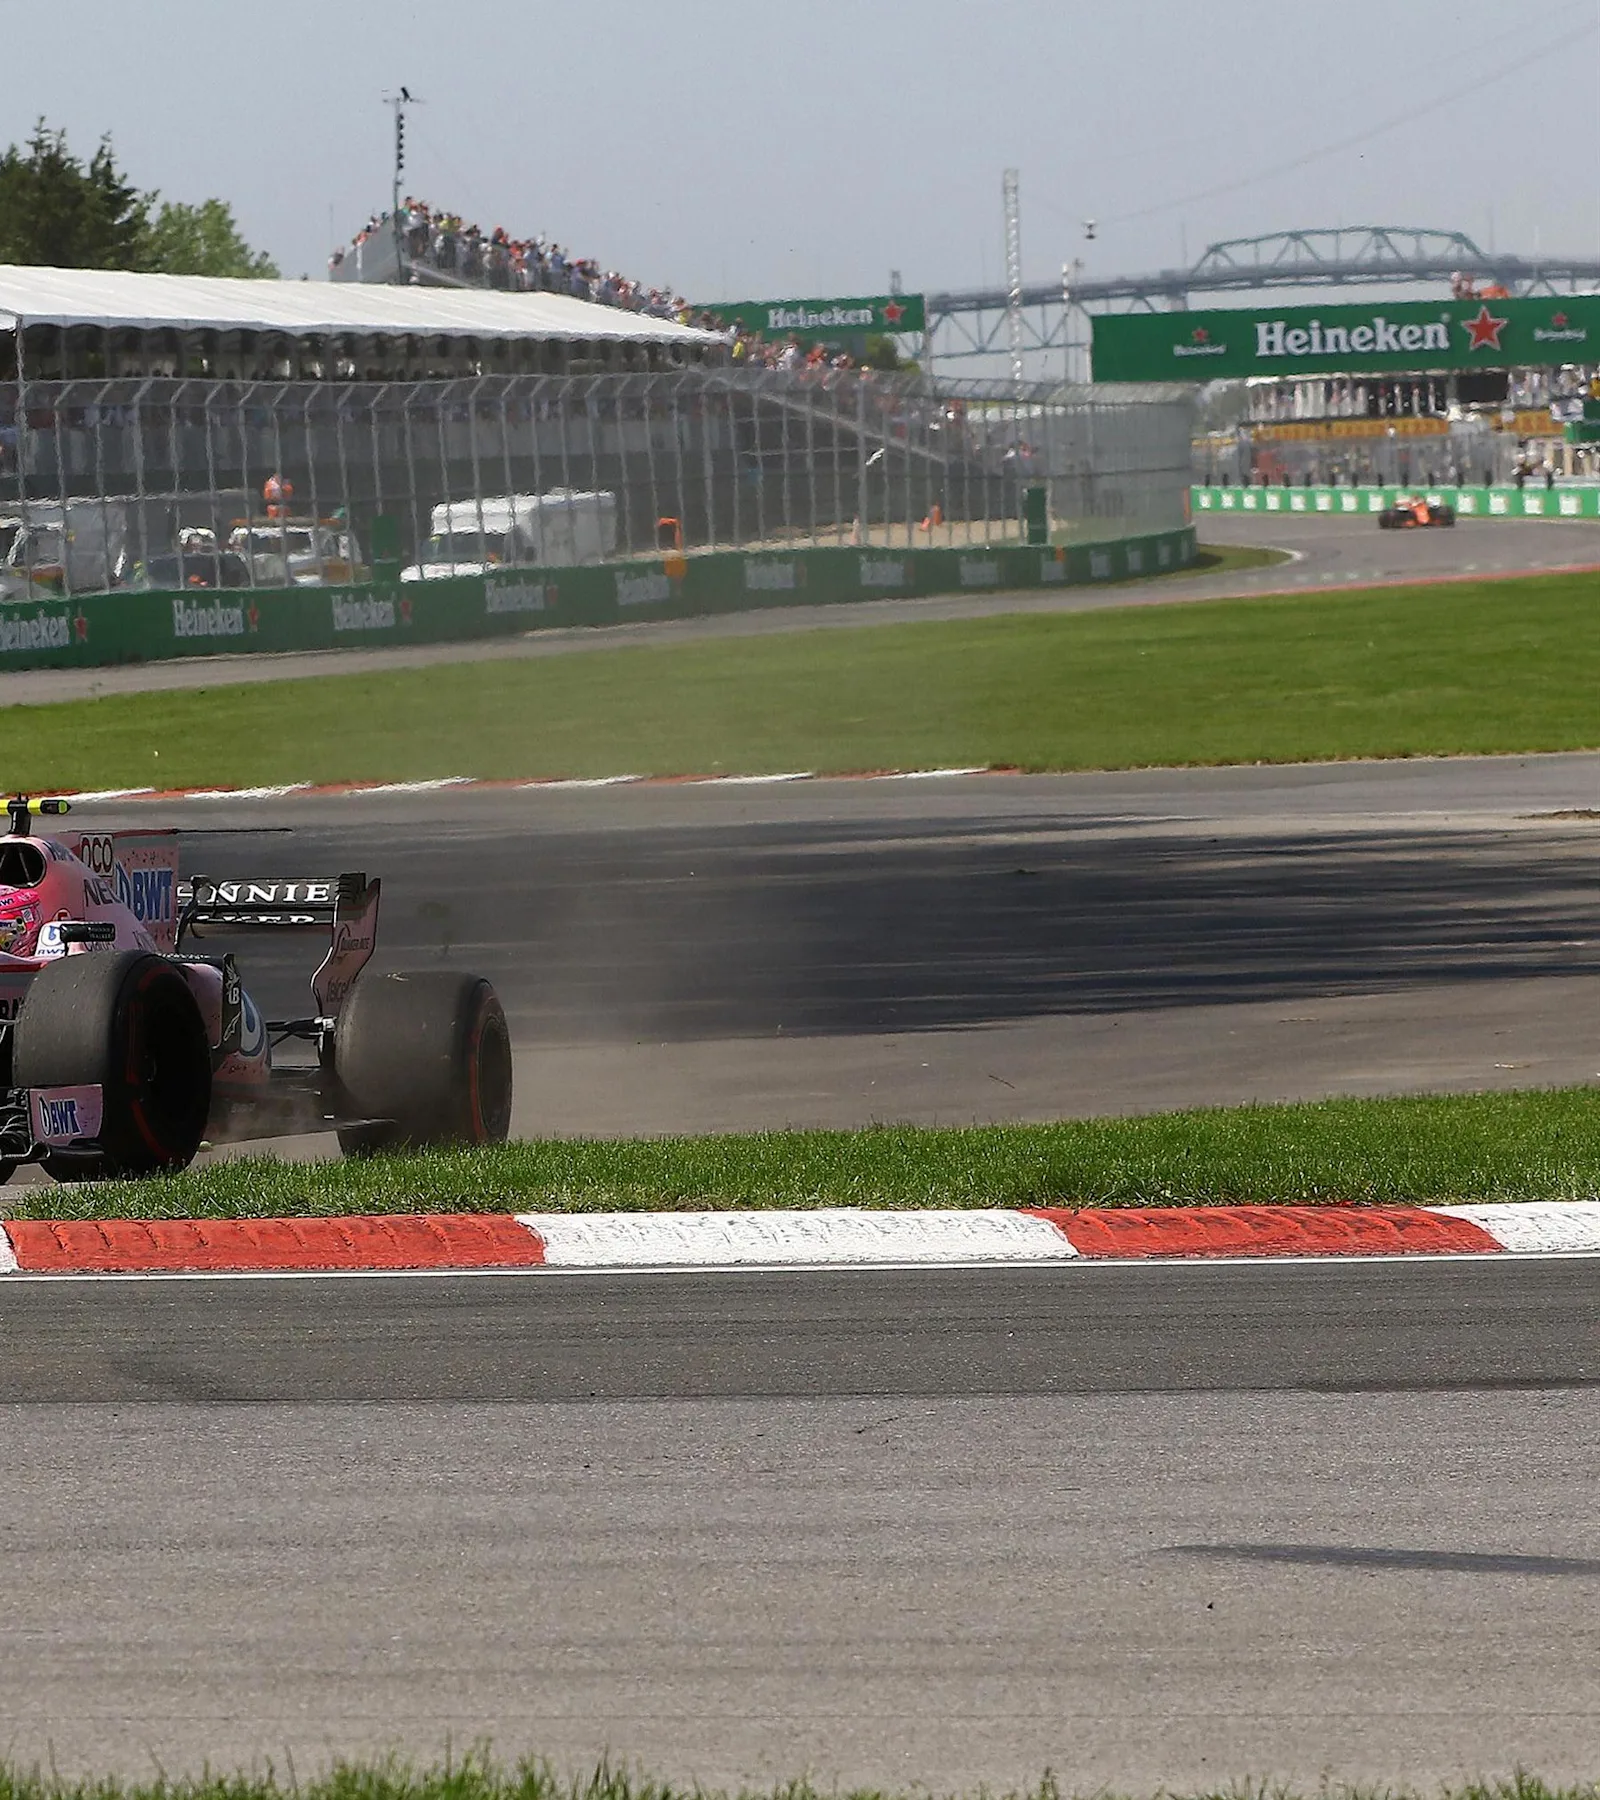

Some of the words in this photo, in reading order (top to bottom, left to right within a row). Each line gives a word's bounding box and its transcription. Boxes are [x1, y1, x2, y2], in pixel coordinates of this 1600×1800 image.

[768, 306, 873, 329] Heineken
[1255, 317, 1450, 358] Heineken
[172, 600, 244, 637] Heineken
[132, 869, 173, 921] BWT
[50, 1100, 83, 1136] BWT
